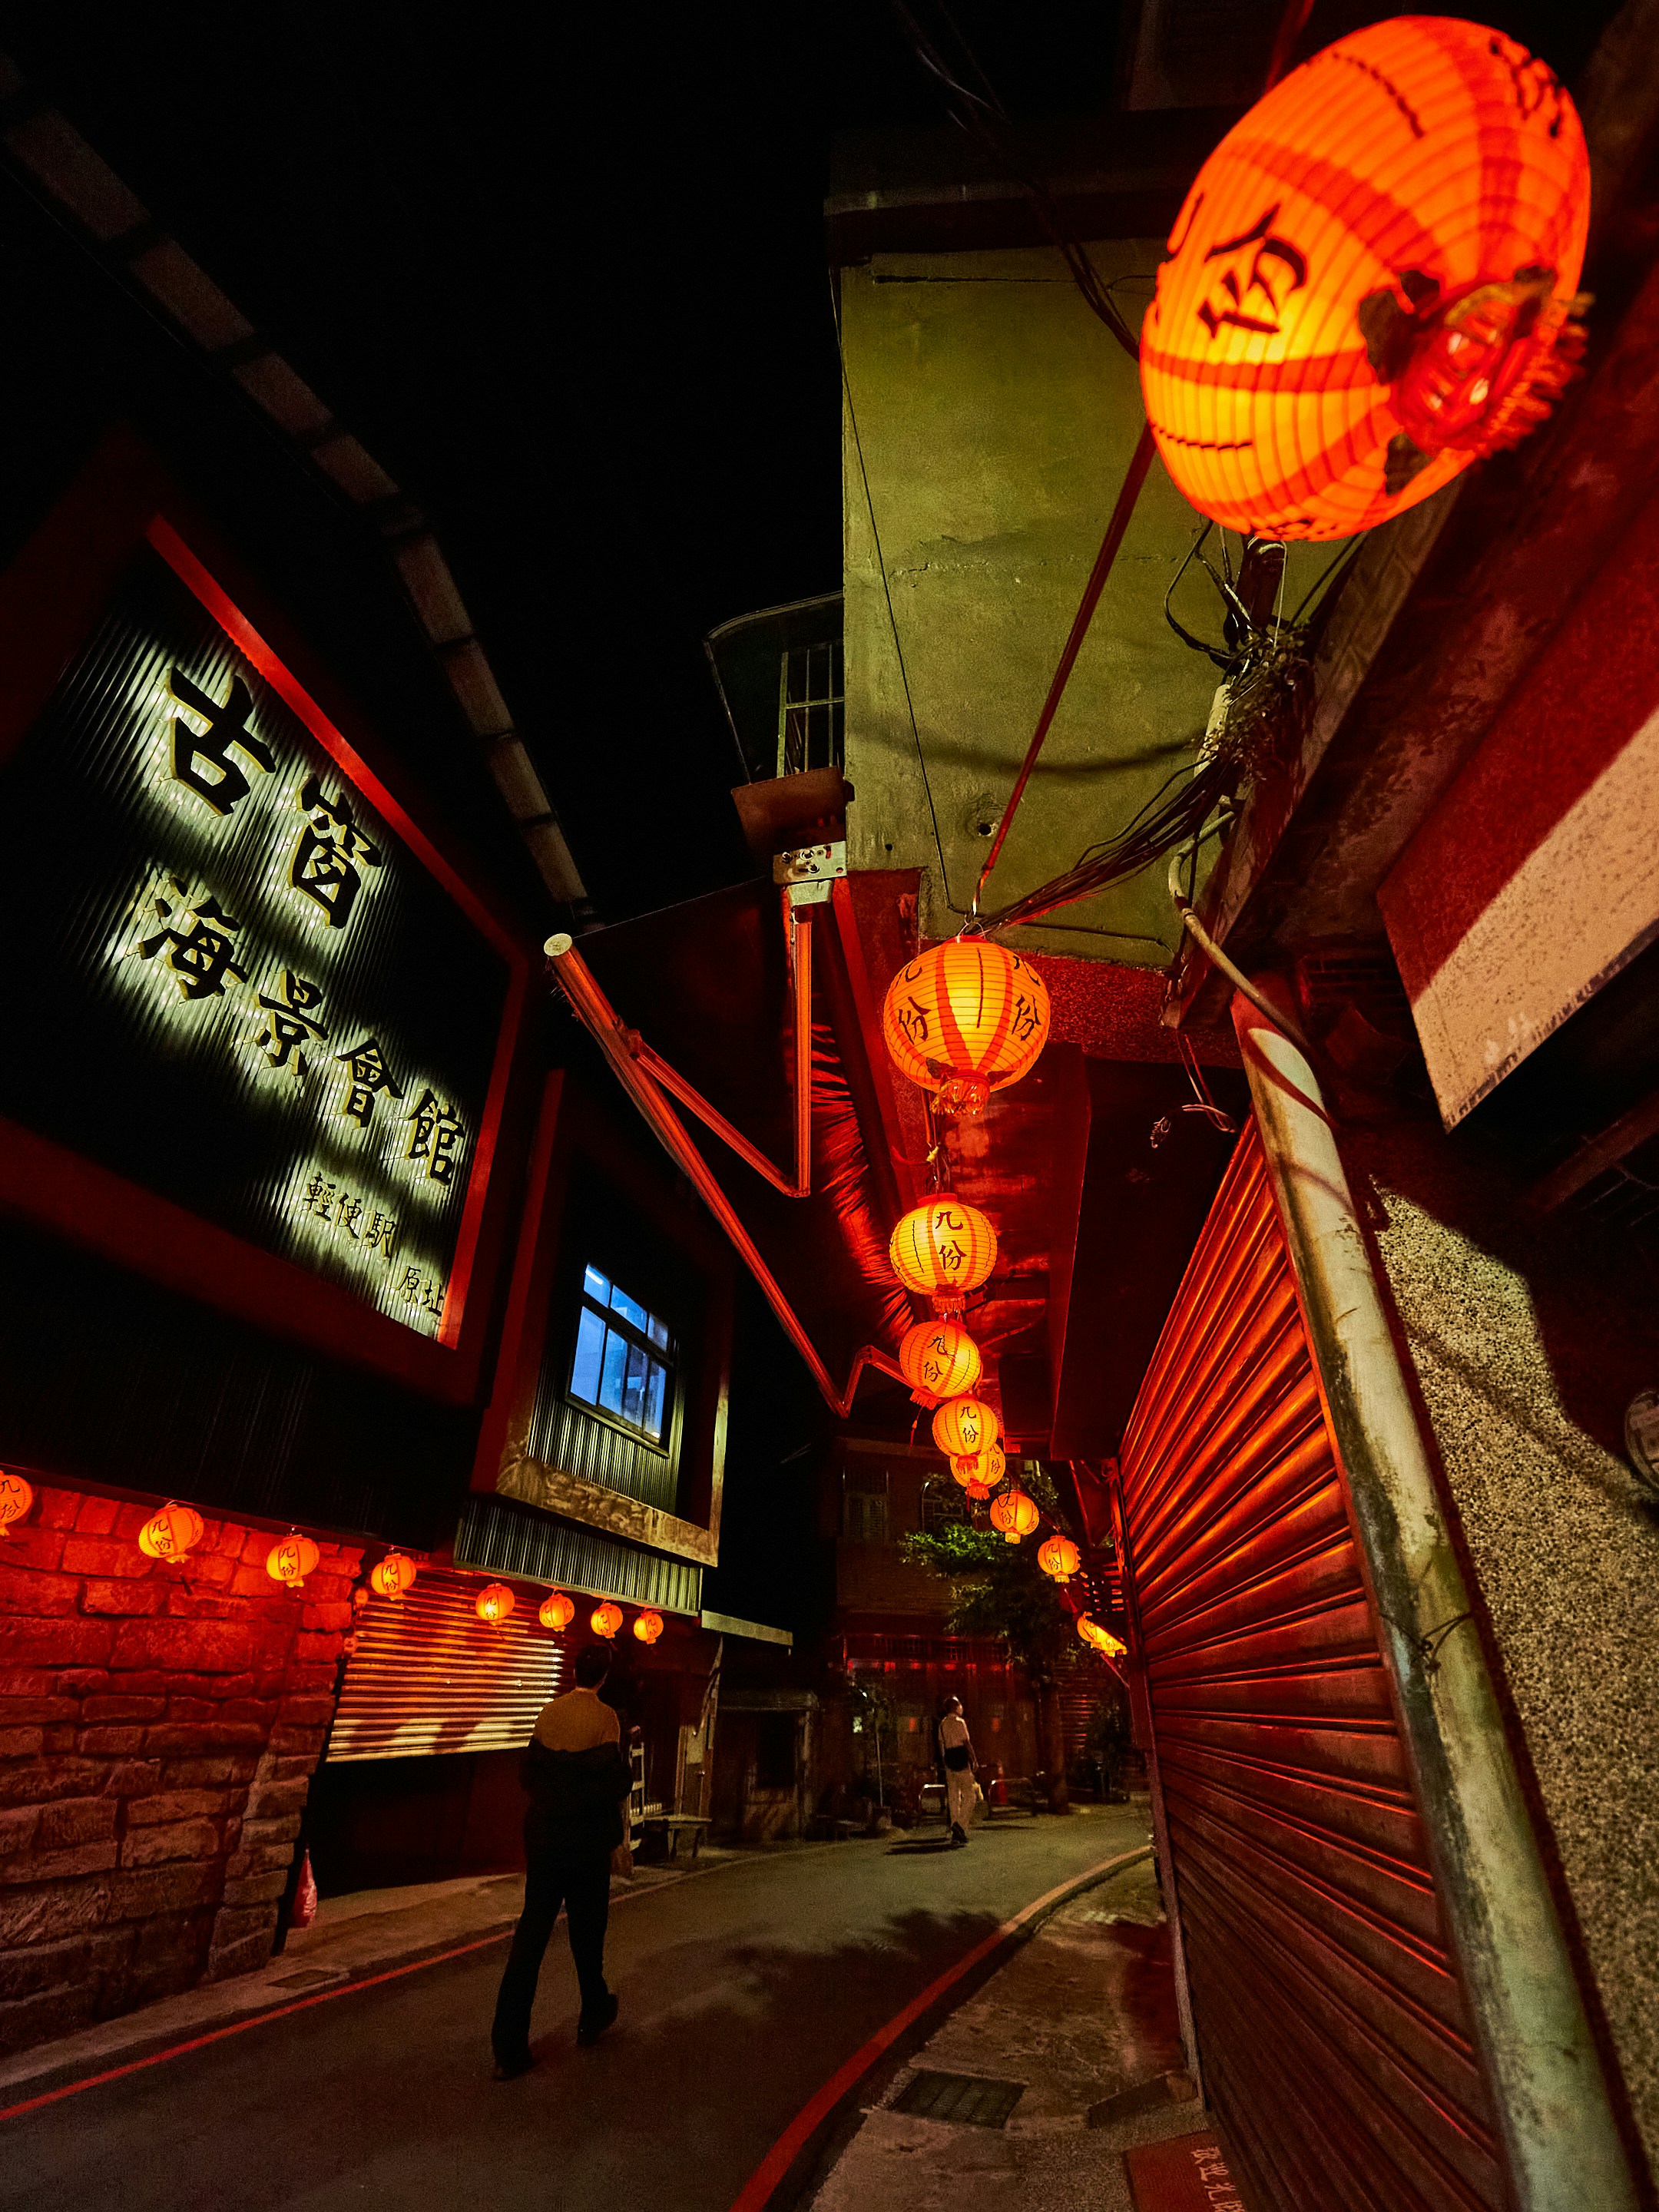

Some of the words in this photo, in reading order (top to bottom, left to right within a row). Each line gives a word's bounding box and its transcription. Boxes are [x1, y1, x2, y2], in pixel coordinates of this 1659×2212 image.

[138, 876, 465, 1185] 海景會館
[935, 1210, 968, 1271] 九份
[394, 1265, 445, 1317] 原址
[923, 1334, 955, 1382] 九份
[959, 1406, 979, 1444] 九份
[152, 1519, 174, 1551] 九份
[280, 1546, 297, 1577] 九份
[1047, 1543, 1061, 1570] 九份
[384, 1563, 398, 1591] 九份
